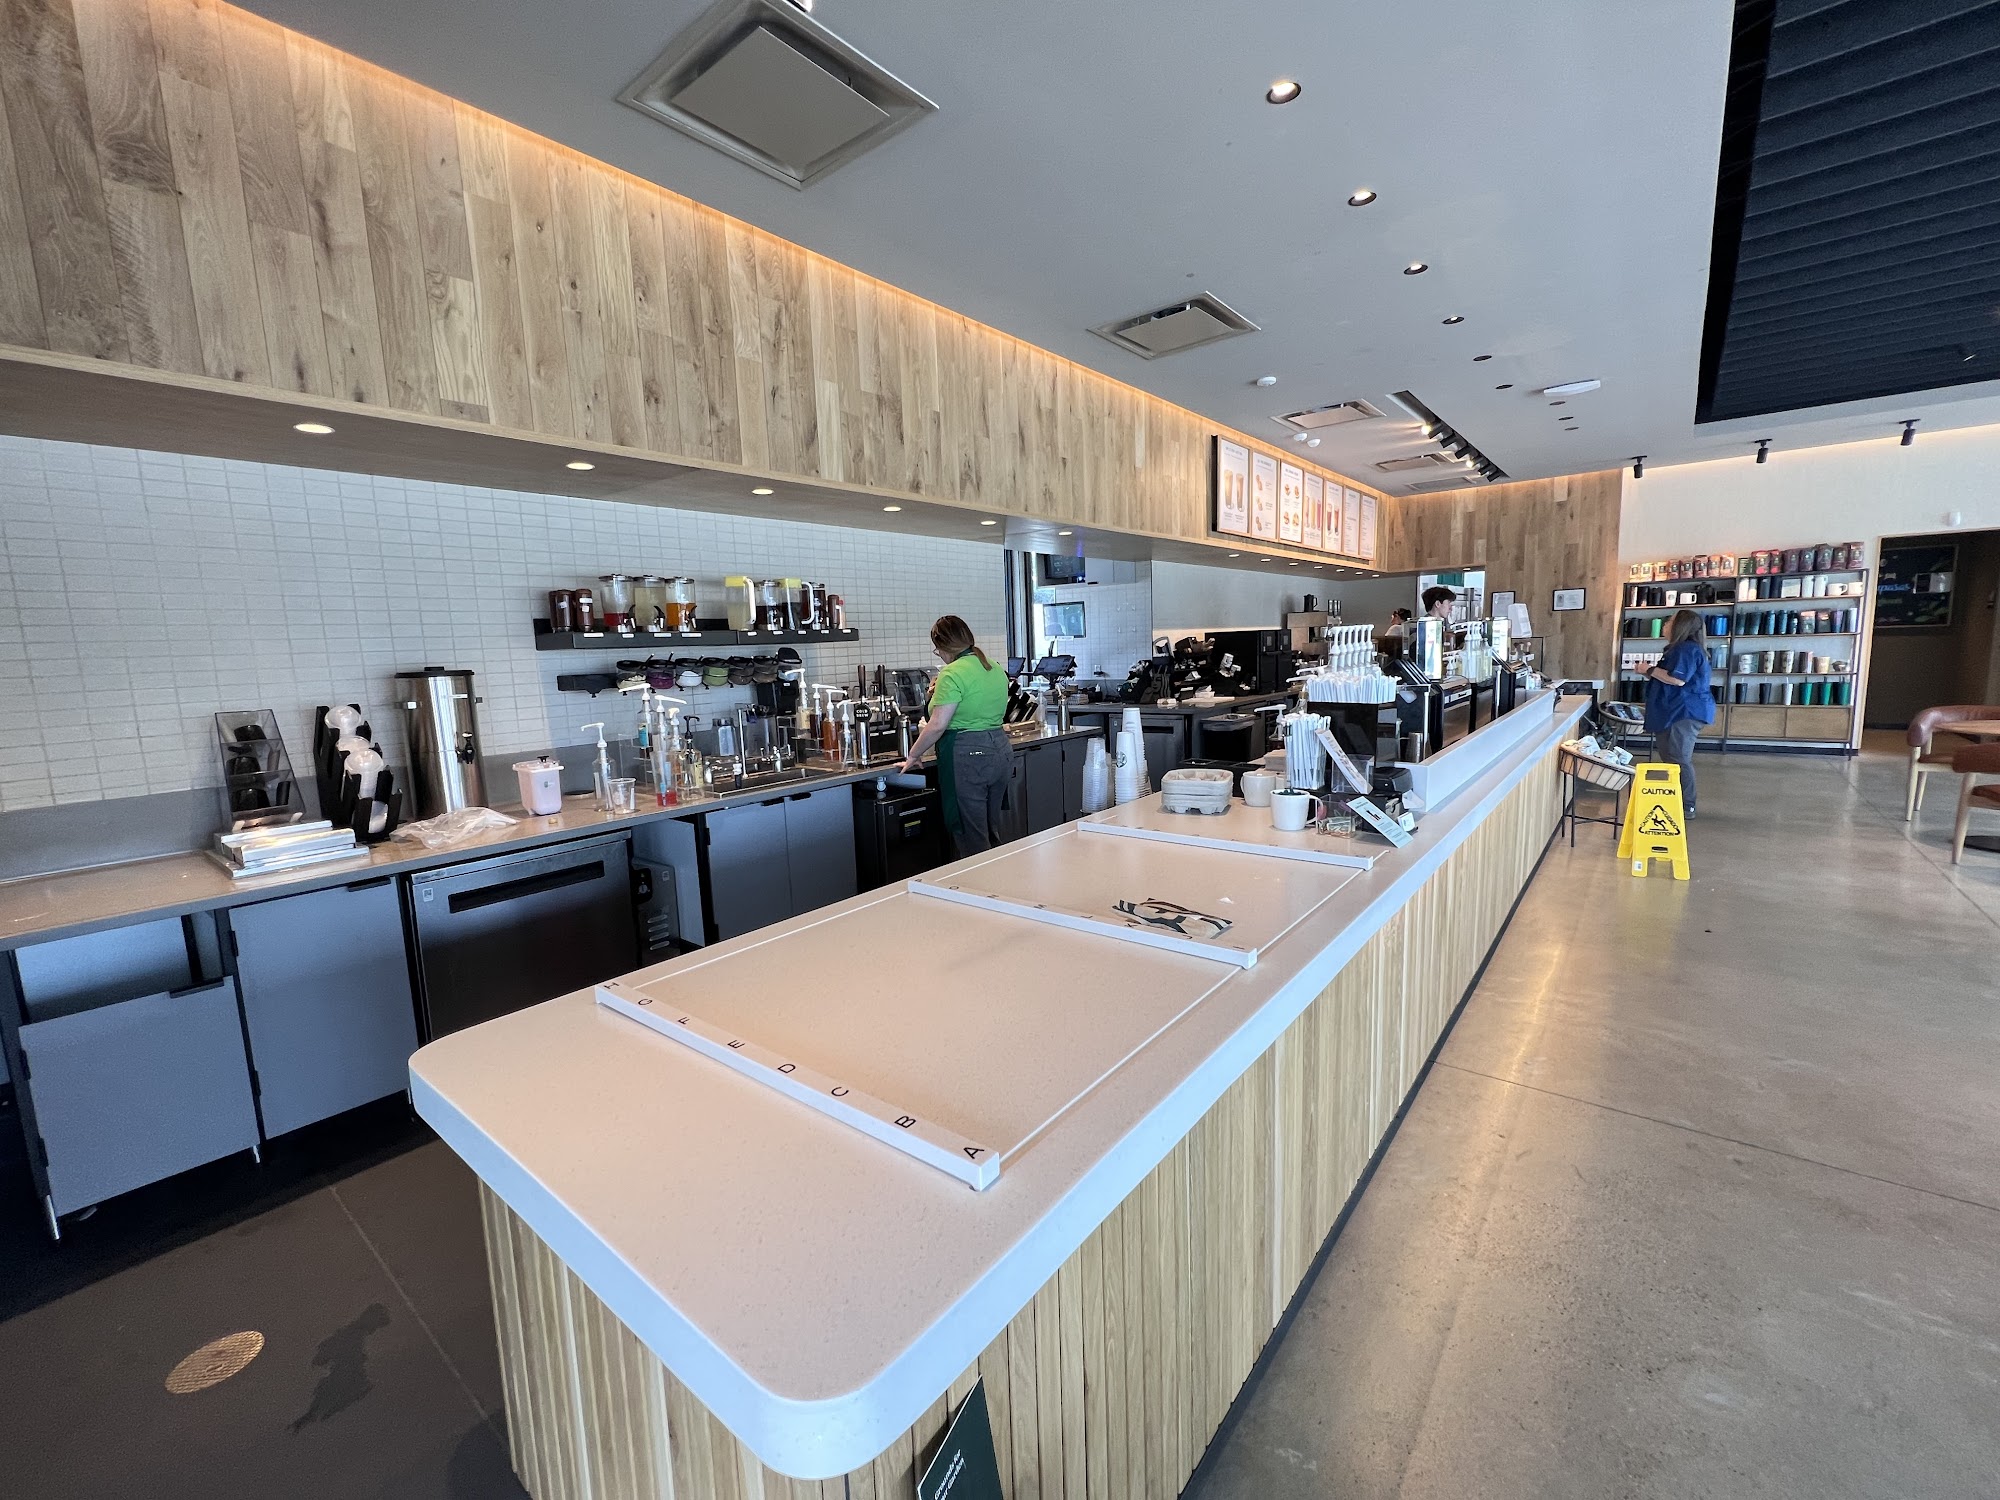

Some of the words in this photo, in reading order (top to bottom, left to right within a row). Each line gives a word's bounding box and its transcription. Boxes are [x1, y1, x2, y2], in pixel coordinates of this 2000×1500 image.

[1642, 788, 1676, 796] CAUTION
[637, 998, 653, 1006] G
[677, 1016, 690, 1025] F
[726, 1039, 746, 1049] E
[777, 1063, 797, 1074] D
[830, 1086, 850, 1097] C
[893, 1115, 917, 1129] B
[963, 1146, 985, 1160] A
